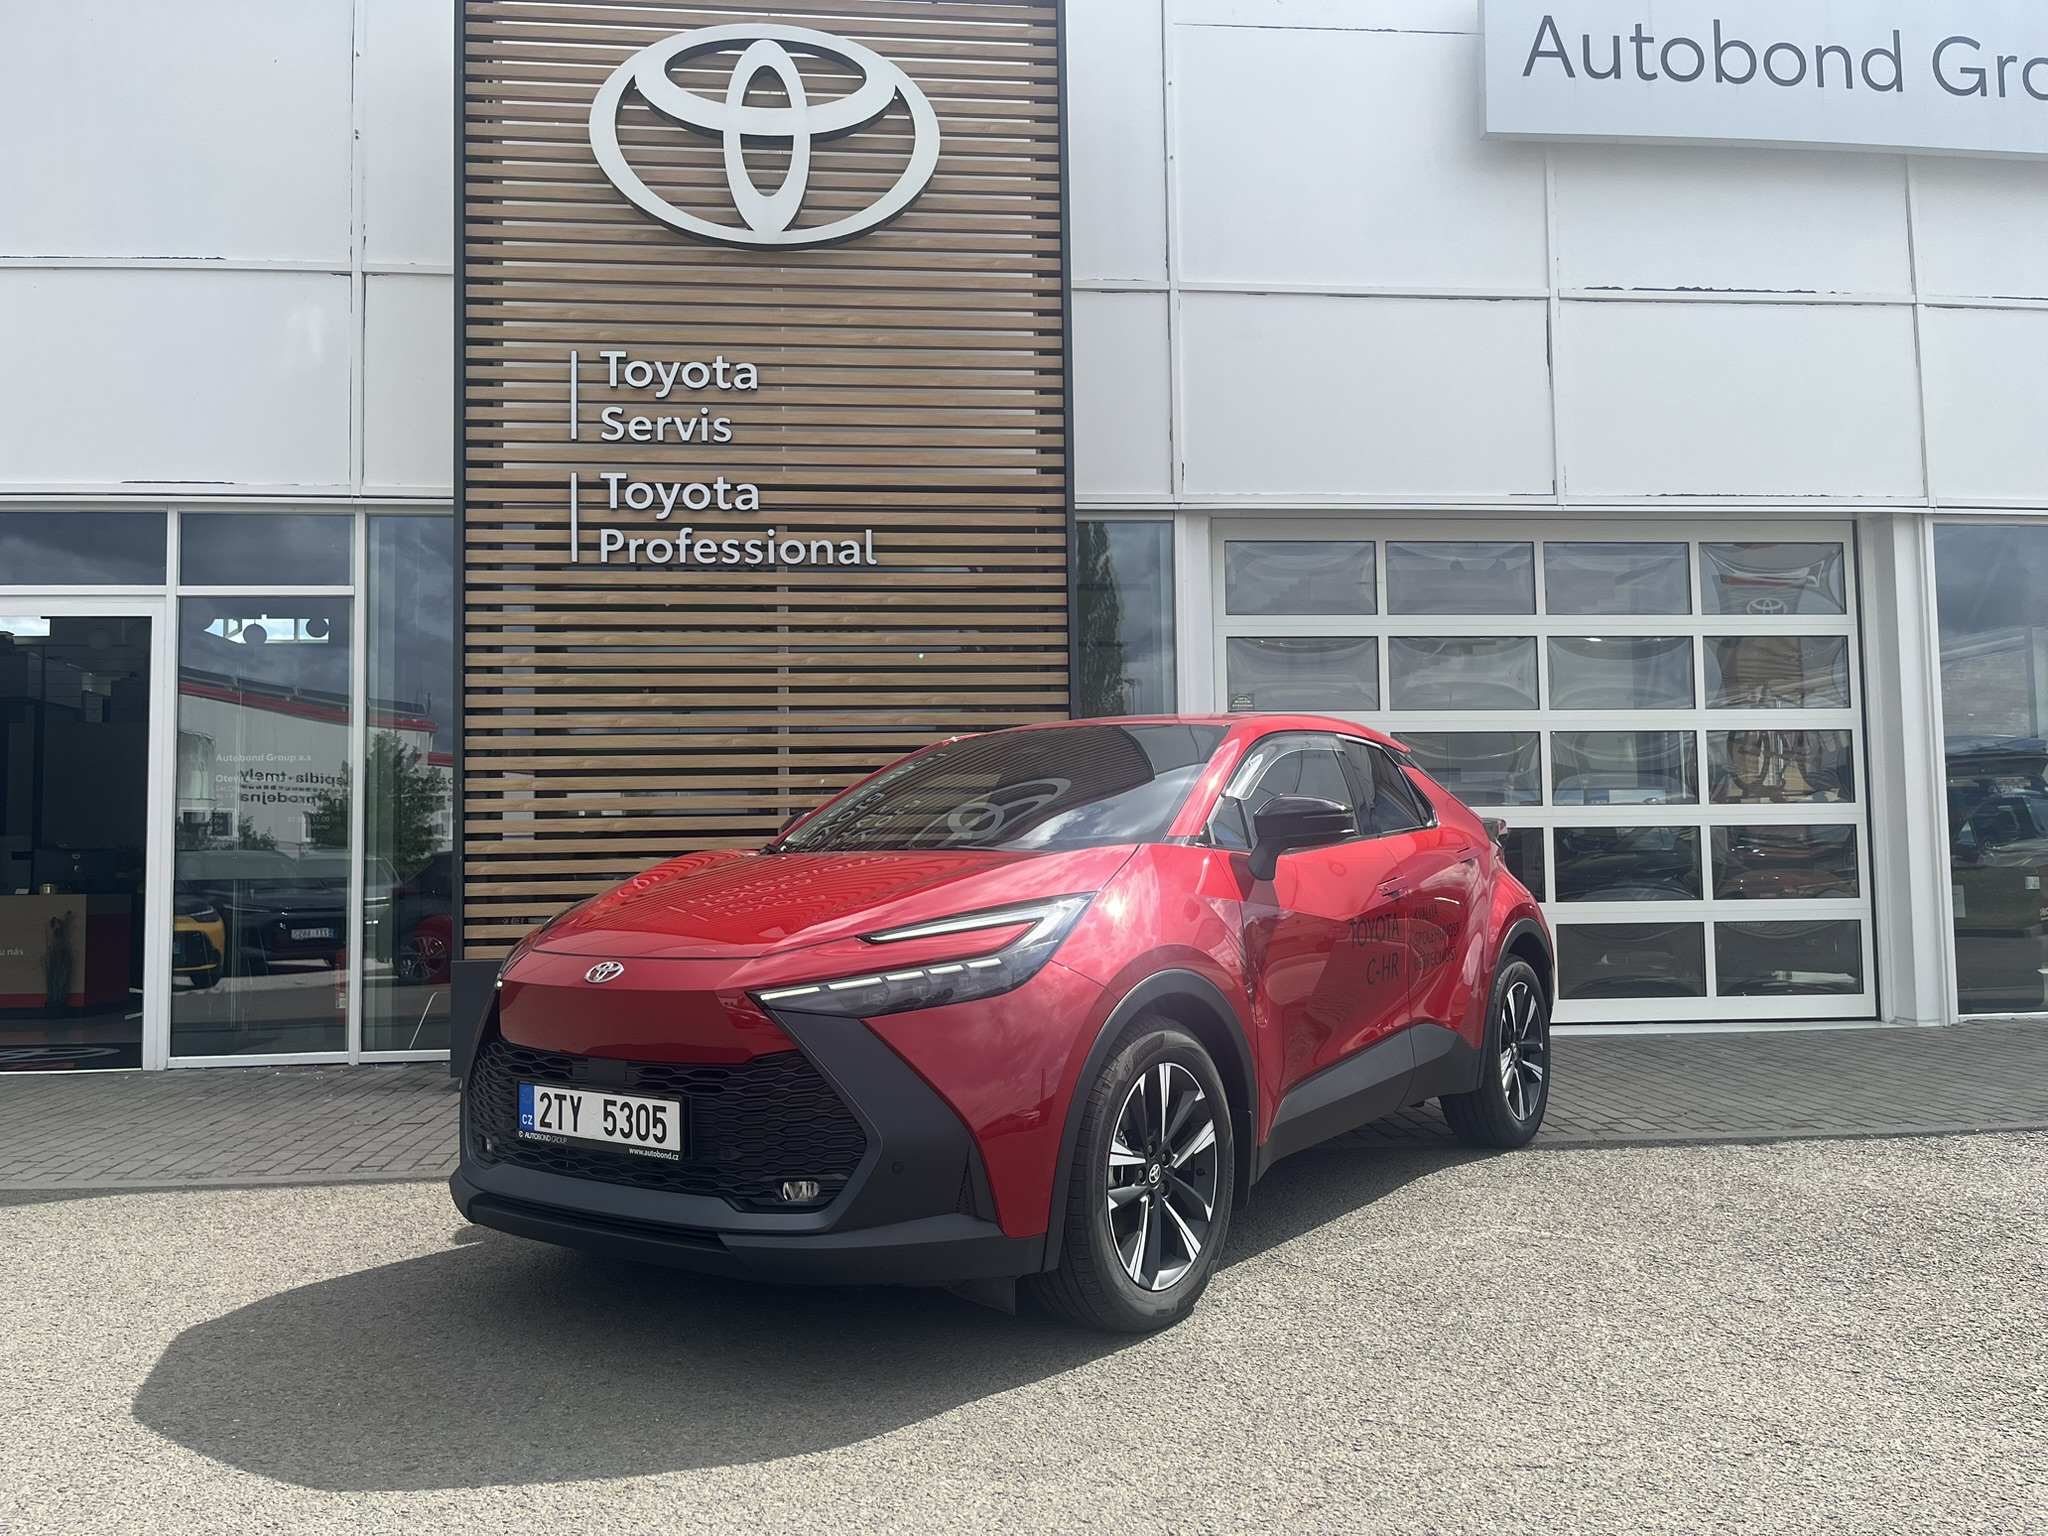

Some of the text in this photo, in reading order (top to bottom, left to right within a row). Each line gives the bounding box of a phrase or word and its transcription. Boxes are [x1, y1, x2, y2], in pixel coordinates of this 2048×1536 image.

[1522, 14, 1904, 93] Autobond
[600, 350, 759, 399] Toyota
[600, 406, 733, 443] Servis
[600, 472, 760, 520] Toyota
[600, 527, 878, 566] Professional
[215, 753, 265, 762] Autobond
[266, 753, 297, 763] Group
[1349, 912, 1400, 949] TOYOTA
[1366, 952, 1399, 985] C-HR
[522, 1114, 533, 1126] CZ
[539, 1092, 667, 1144] 2TY 5305
[524, 1131, 568, 1144] AUTOBOND GROUP
[628, 1147, 679, 1161] www.autobond.cz
